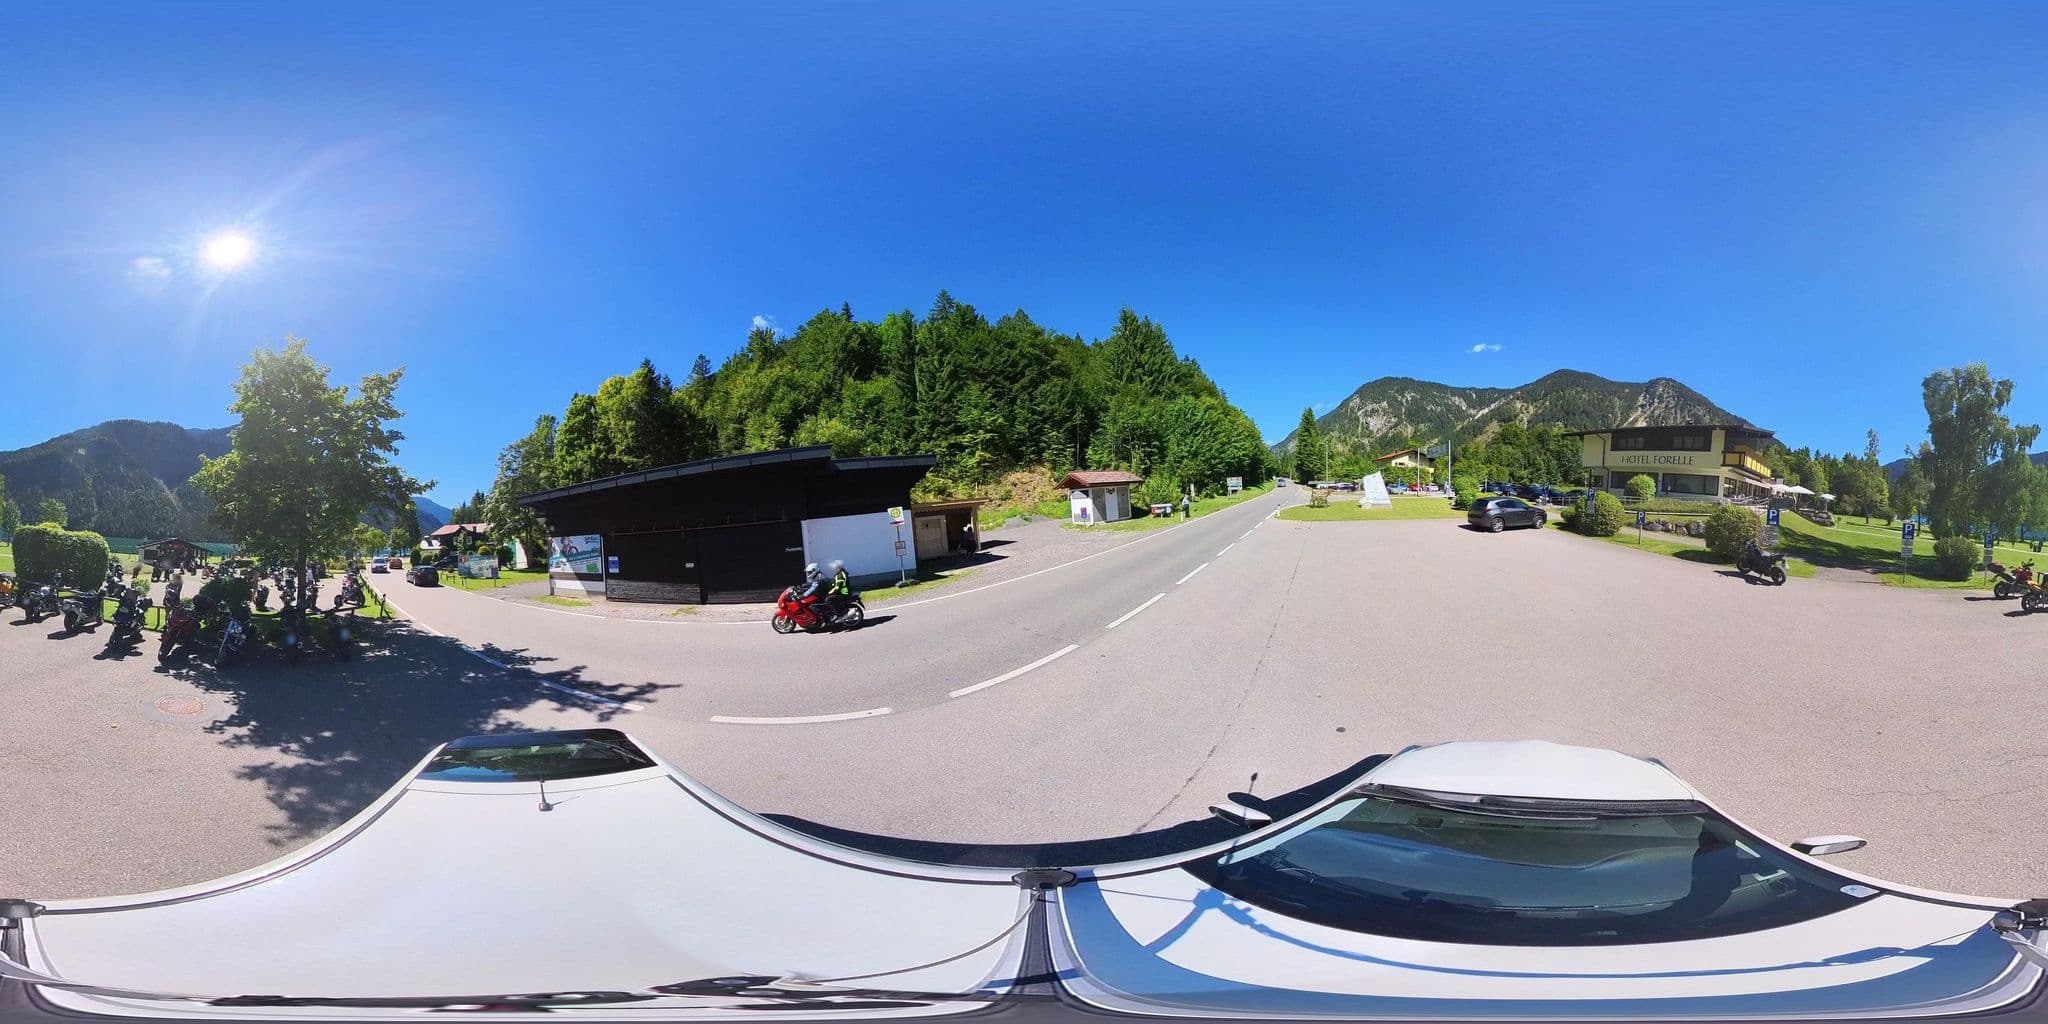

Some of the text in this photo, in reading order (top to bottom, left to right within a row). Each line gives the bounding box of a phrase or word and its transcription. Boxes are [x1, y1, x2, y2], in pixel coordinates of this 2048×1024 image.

[1621, 455, 1695, 465] HOTEL FORELLE
[1770, 510, 1777, 519] P
[1905, 524, 1912, 533] P
